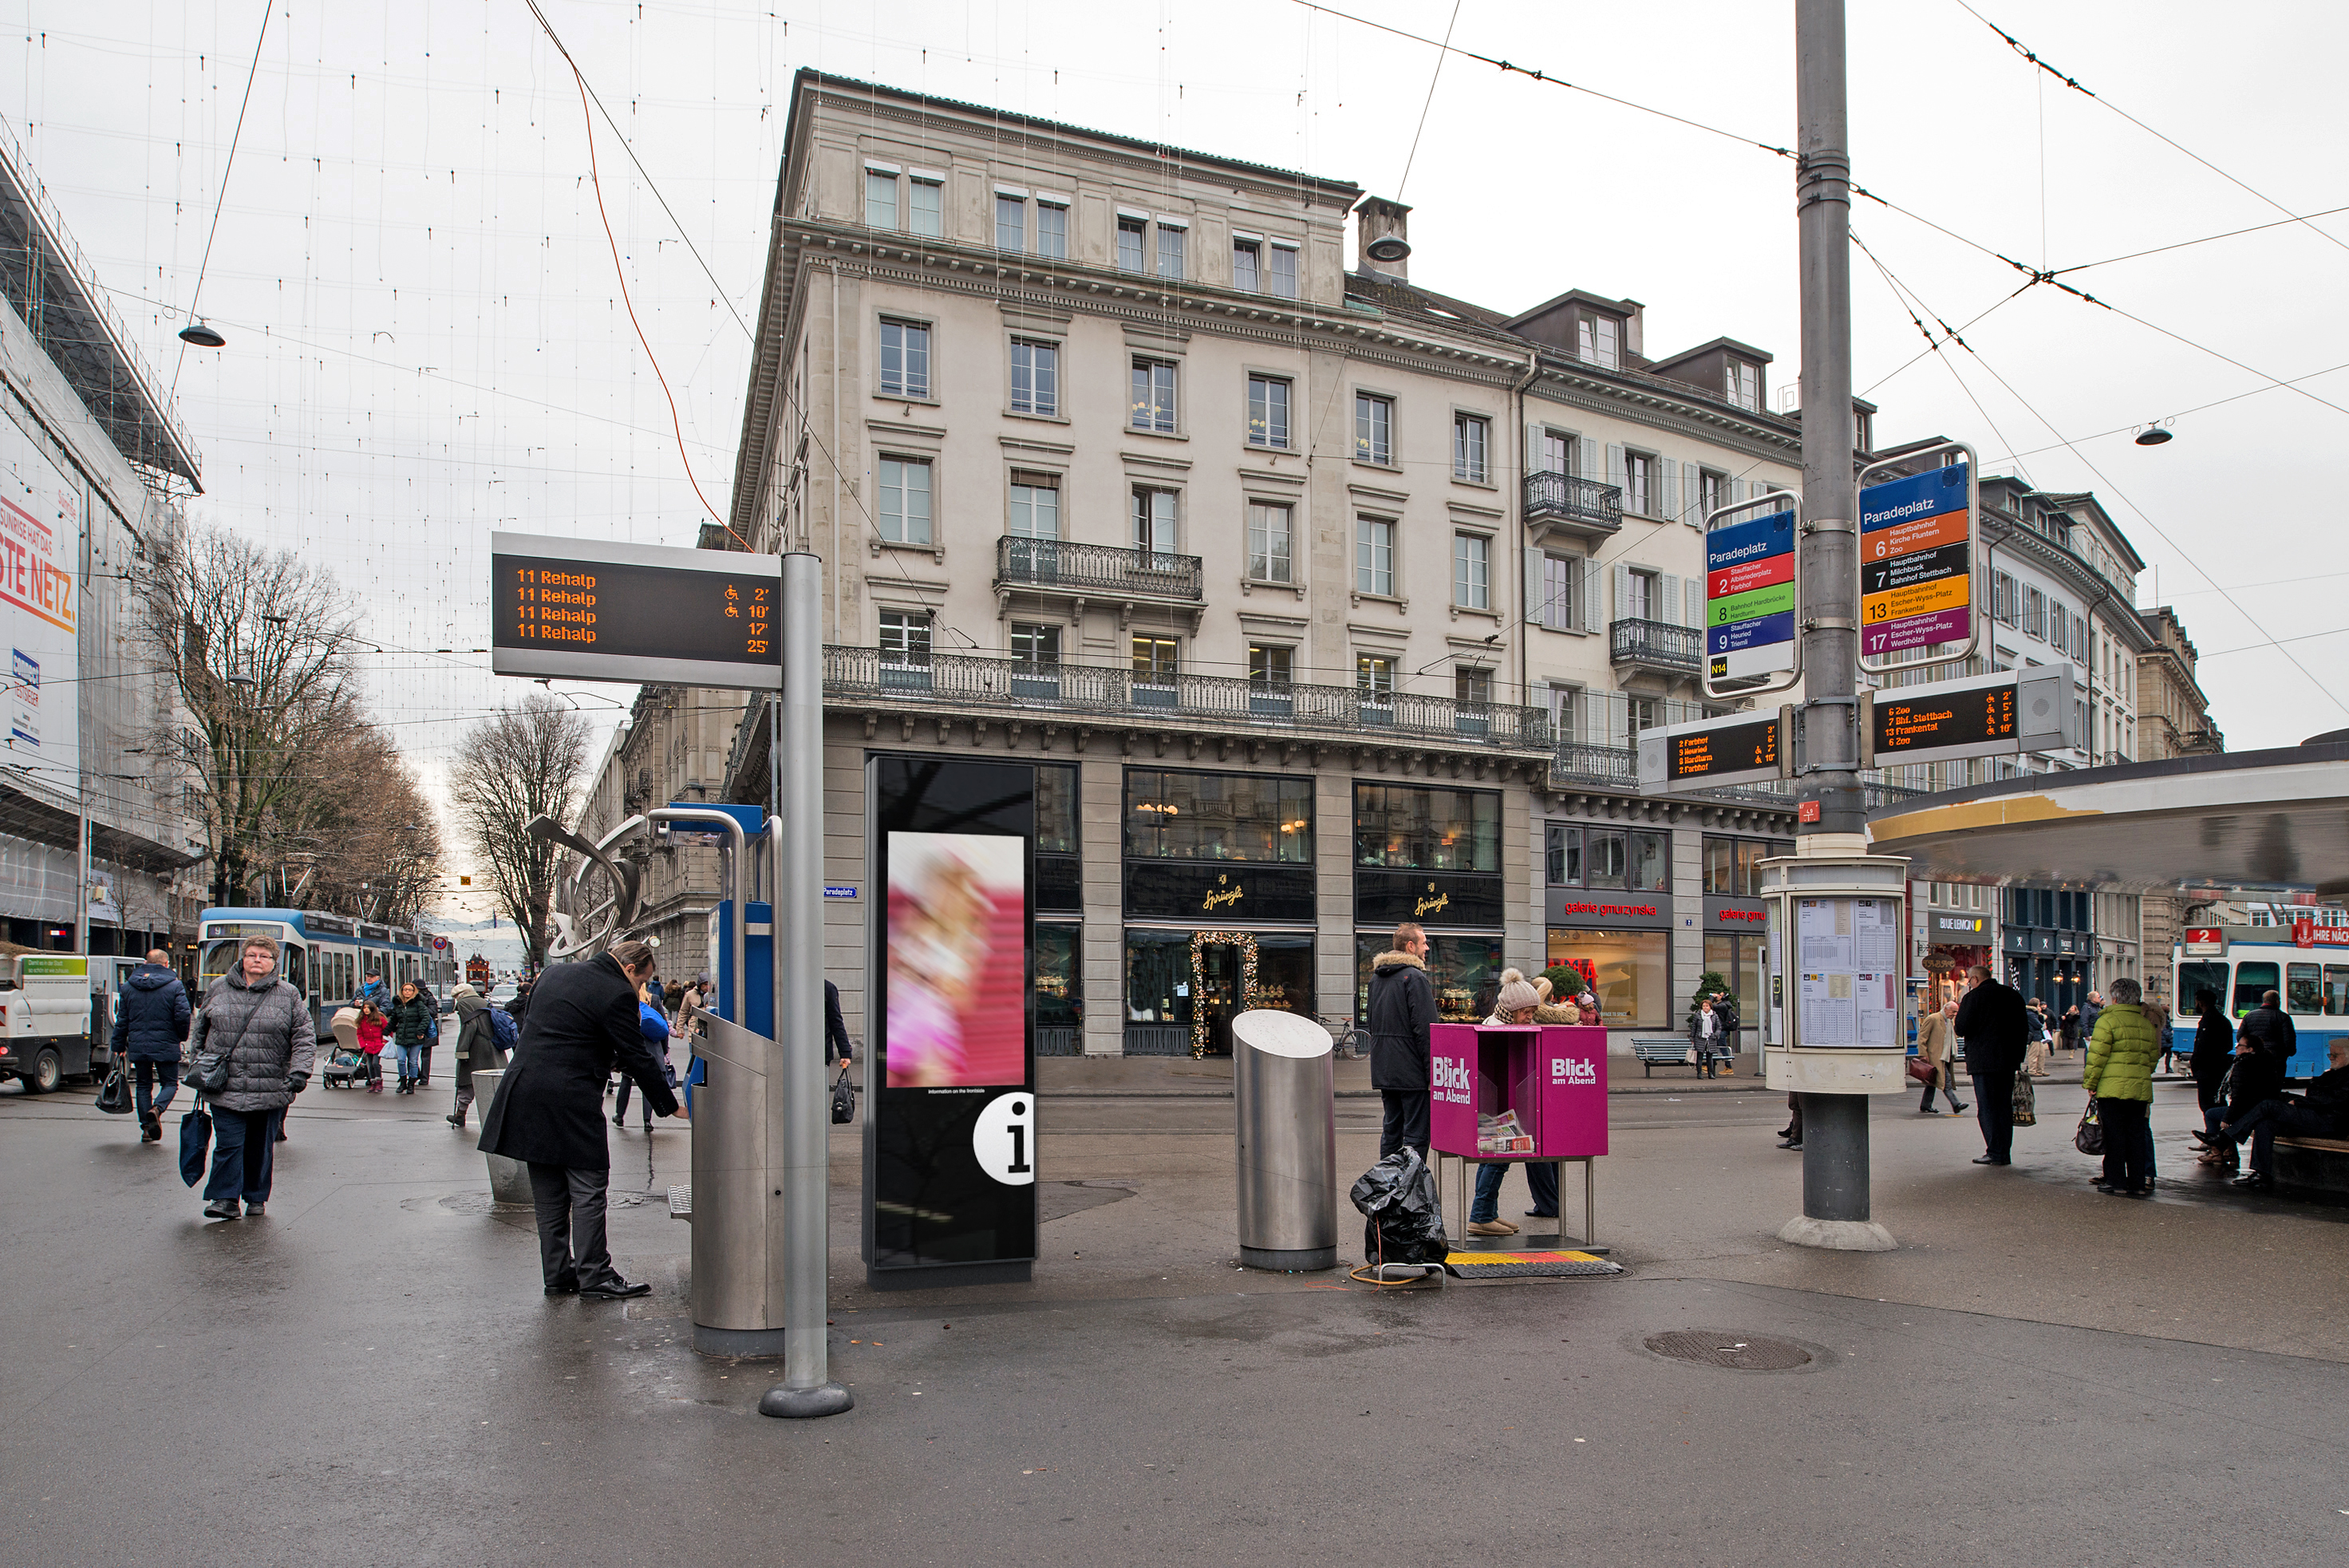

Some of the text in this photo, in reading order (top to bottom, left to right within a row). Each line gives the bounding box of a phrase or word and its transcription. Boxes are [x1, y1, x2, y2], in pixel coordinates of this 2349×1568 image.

[58, 489, 76, 519] Sunrise
[1864, 498, 1934, 525] Paradeplatz
[1, 508, 52, 557] SUNRISE HAT DAS
[1889, 519, 1936, 536] Hauptbahnhof
[1889, 528, 1940, 545] Kirche Fluntern
[1709, 541, 1767, 565] Paradeplatz
[1875, 540, 1886, 557] 6
[1889, 545, 1903, 554] Zoo
[1890, 551, 1937, 568] Hauptbahnhof
[1731, 562, 1762, 575] Stauffacher
[1731, 568, 1772, 584] Albisriederplatz
[1890, 563, 1925, 576] Milchbuck
[1890, 566, 1952, 587] Bahnhof Stettbach
[31, 552, 76, 622] NETZ.
[517, 569, 769, 602] 11 Rehalp 2'
[1719, 579, 1727, 594] 2
[1731, 580, 1752, 591] Farbhof
[1876, 571, 1886, 588] 7
[1890, 583, 1937, 599] Hauptbahnhof
[1890, 590, 1952, 608] Escher-Wyss-Platz
[517, 587, 769, 618] 11 Rehalp 10'
[1730, 594, 1786, 611] Bahnhof Hardbrücke
[1869, 602, 1886, 618] 13
[1890, 602, 1925, 616] Frankental
[517, 605, 535, 619] 11
[541, 606, 596, 626] Rehalp
[1719, 607, 1727, 622] 8
[1730, 609, 1756, 620] Hardturm
[1890, 614, 1937, 630] Hauptbahnhof
[1731, 619, 1762, 632] Stauffacher
[1890, 622, 1953, 639] Escher-Wyss-Platz
[517, 623, 768, 654] 11 Rehalp 25'
[1719, 635, 1727, 650] 9
[1731, 630, 1751, 641] Heuried
[1731, 638, 1748, 648] Triemli
[1869, 634, 1887, 651] 17
[1890, 635, 1925, 648] Werdhölzli
[14, 655, 38, 685] connect
[1711, 663, 1727, 675] N14
[14, 681, 38, 708] TESTSIEGER
[1896, 715, 1911, 725] Bhf.
[1913, 710, 1952, 723] Stettbach
[1896, 723, 1938, 736] Frankental
[1684, 737, 1708, 747] Farbhof
[1684, 745, 1707, 756] Heuried
[1684, 754, 1712, 764] Hardturm
[1684, 763, 1708, 773] Farbhof
[823, 887, 853, 897] Paradeplatz
[1203, 885, 1243, 910] Sprüngli
[1415, 892, 1449, 917] Sprüngli
[1565, 901, 1657, 917] galerie gmurzynska
[1719, 908, 1746, 921] galerie
[215, 926, 278, 935] 9 Hirzenbach
[1940, 918, 1975, 930] BLUE LEMON
[2199, 930, 2209, 942] 2
[2313, 929, 2330, 942] IHRE
[1923, 959, 1955, 968] TABAC
[2325, 973, 2330, 981] 2
[1432, 1057, 1471, 1090] Blick
[1552, 1058, 1596, 1076] Blick
[1568, 1076, 1596, 1085] Abend
[1433, 1088, 1471, 1104] am Abend
[1007, 1101, 1030, 1174] i
